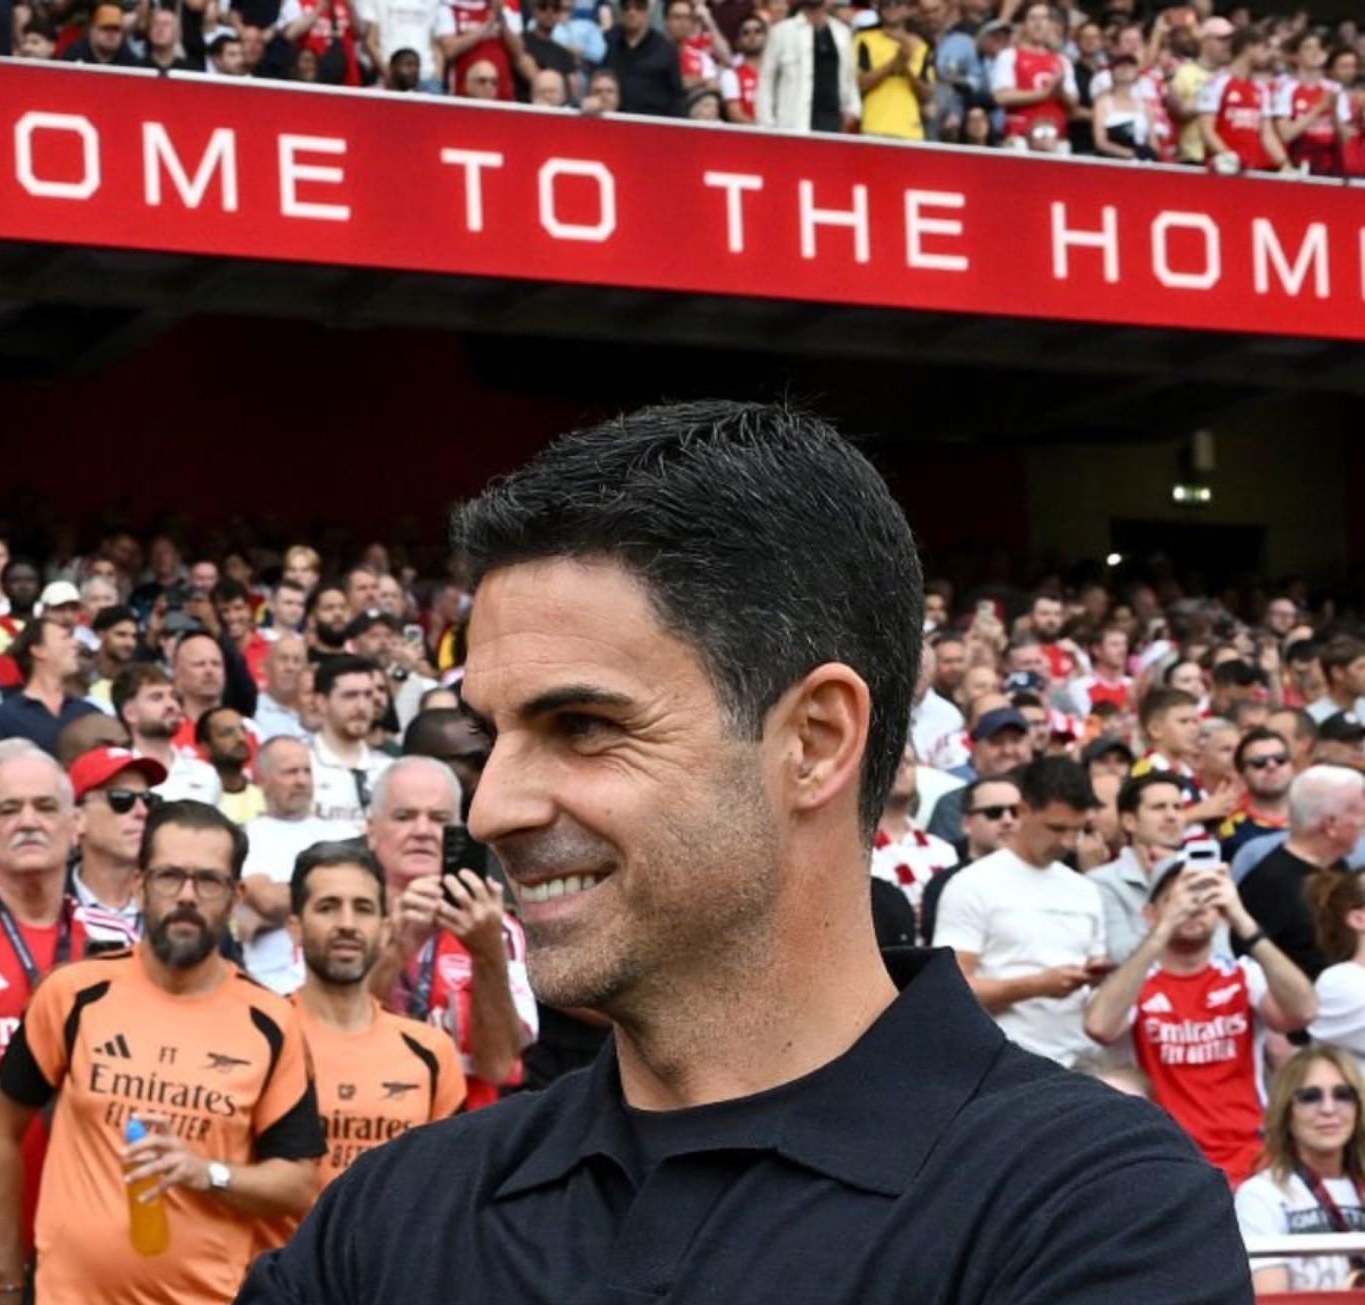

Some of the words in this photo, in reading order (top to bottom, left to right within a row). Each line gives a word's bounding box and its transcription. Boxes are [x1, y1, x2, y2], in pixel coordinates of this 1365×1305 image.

[440, 147, 617, 243] TO
[703, 170, 969, 272] THE
[1051, 201, 1365, 302] HOM
[158, 1046, 177, 1065] FT
[89, 1062, 237, 1118] Emirates
[104, 1101, 137, 1129] FL
